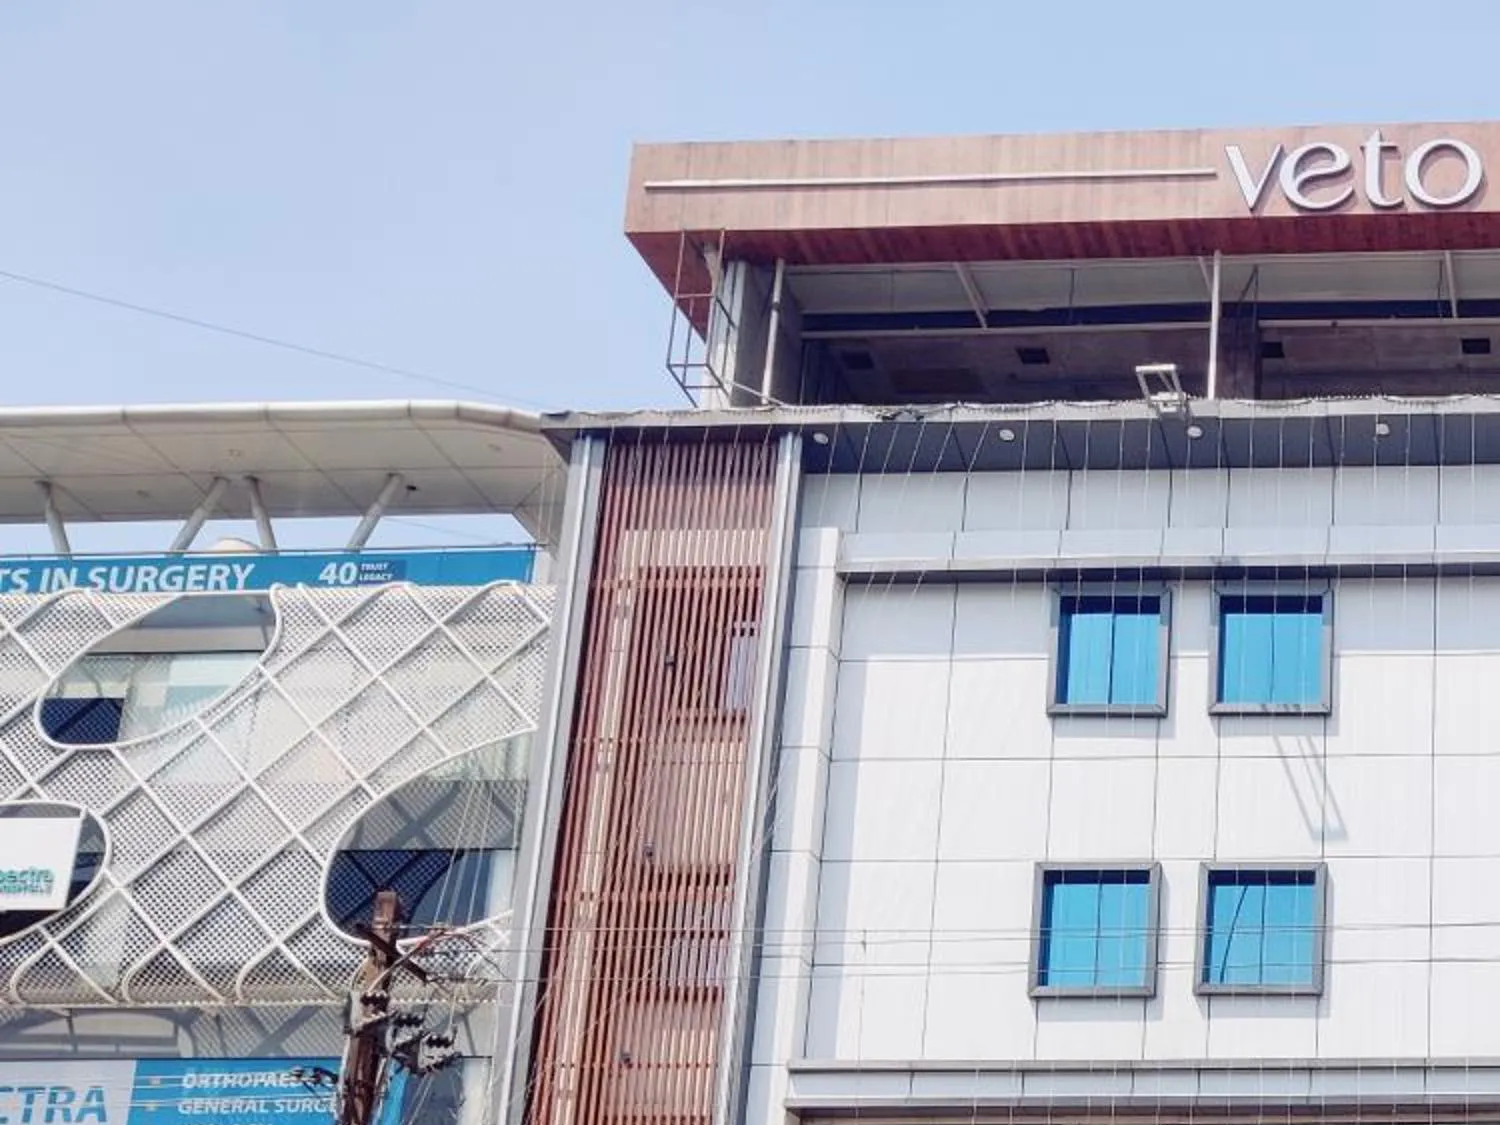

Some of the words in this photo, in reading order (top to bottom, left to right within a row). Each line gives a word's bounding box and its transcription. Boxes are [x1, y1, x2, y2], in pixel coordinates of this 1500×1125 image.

[1224, 129, 1483, 211] veto
[40, 567, 78, 590] IN
[88, 563, 256, 592] SURGERY
[319, 562, 358, 584] 40
[178, 1098, 269, 1115] GENERAL
